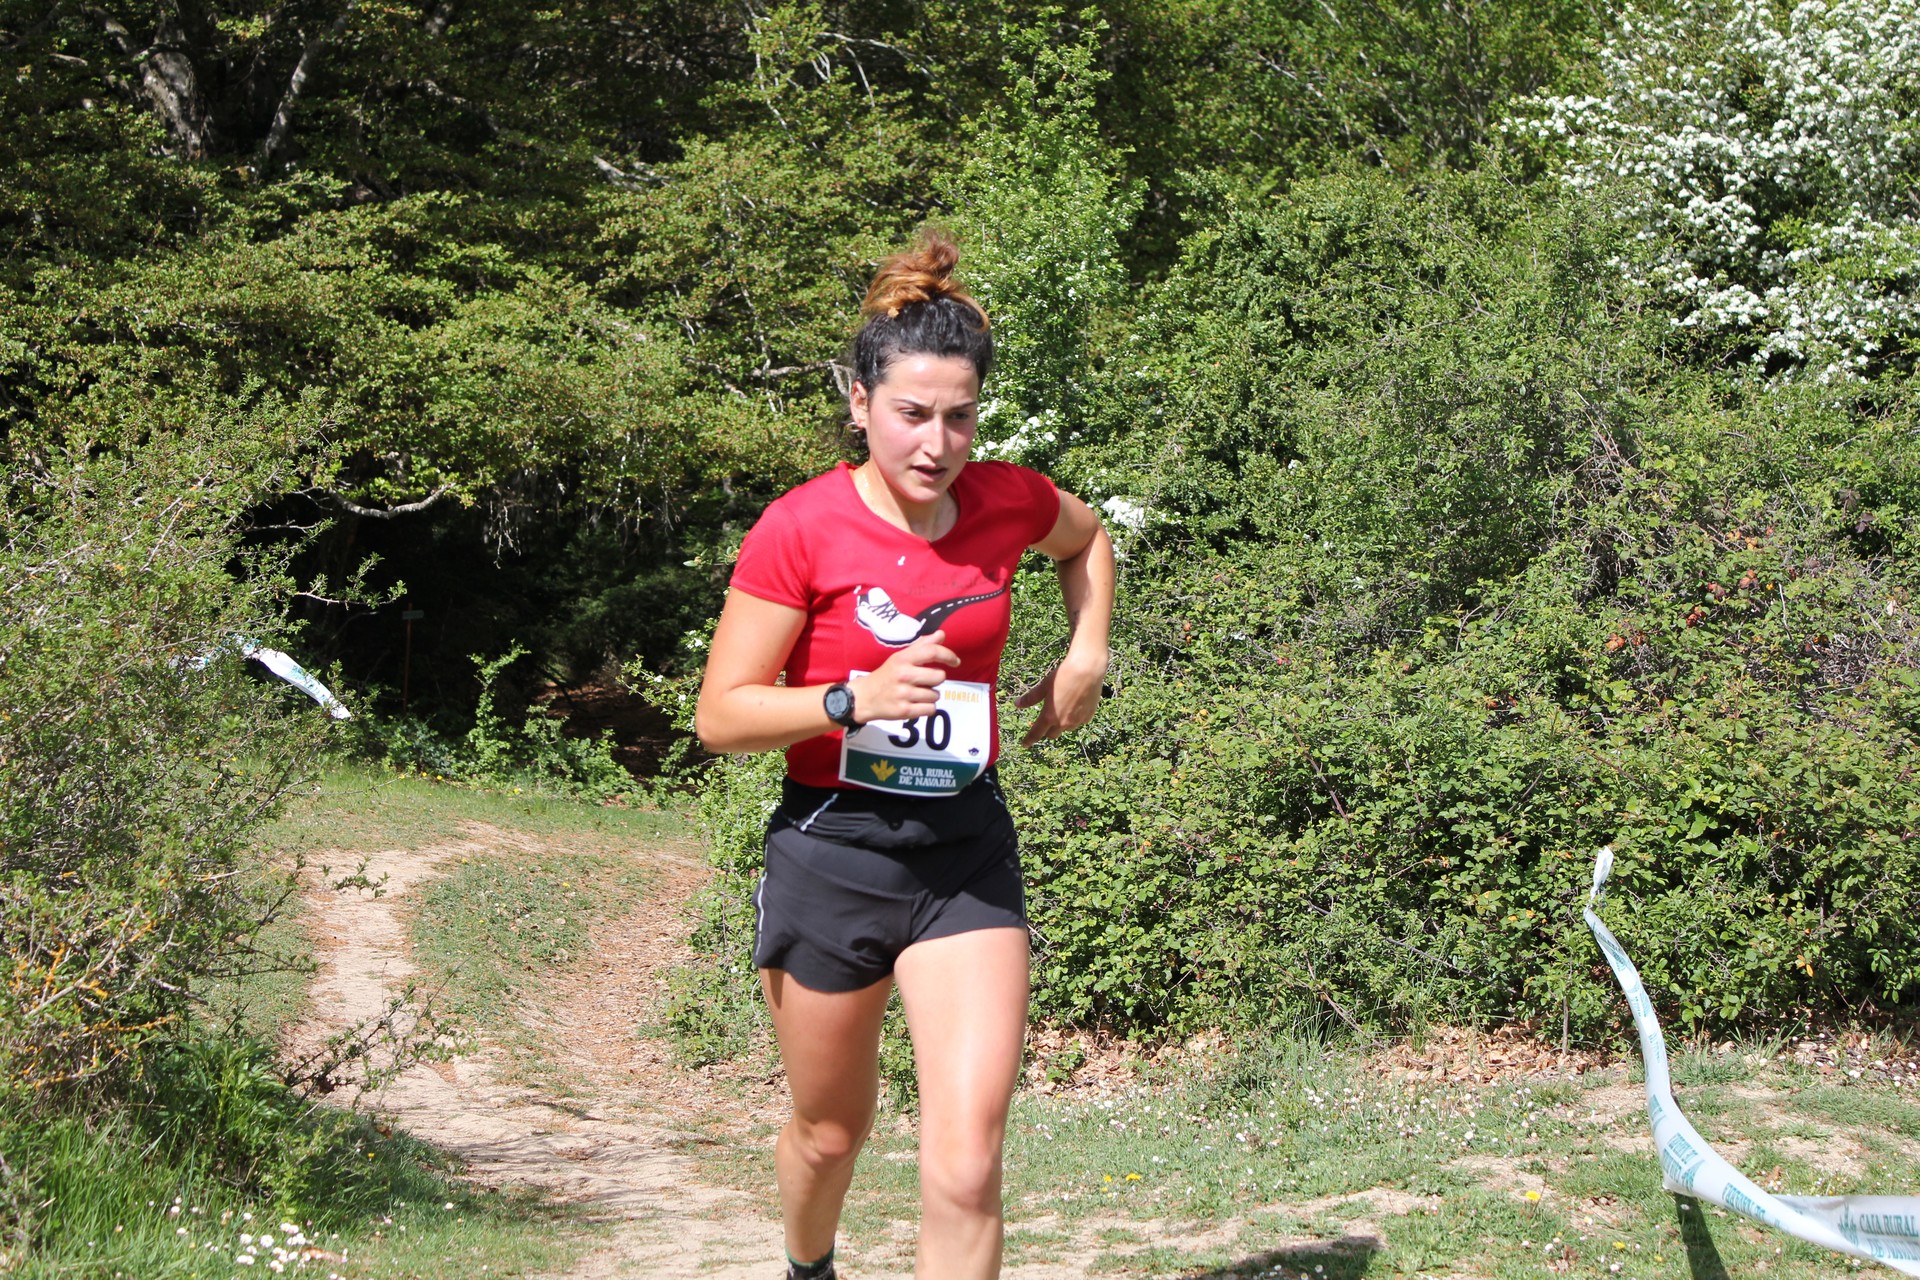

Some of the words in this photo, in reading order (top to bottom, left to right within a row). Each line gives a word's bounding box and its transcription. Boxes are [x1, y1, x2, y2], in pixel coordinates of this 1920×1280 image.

[888, 709, 951, 751] 30
[898, 775, 912, 786] DE
[914, 776, 956, 788] NAVARRA
[900, 766, 924, 777] CAJA
[926, 768, 954, 779] RURAL
[1882, 1214, 1919, 1238] RURAL
[1866, 1238, 1885, 1259] DE
